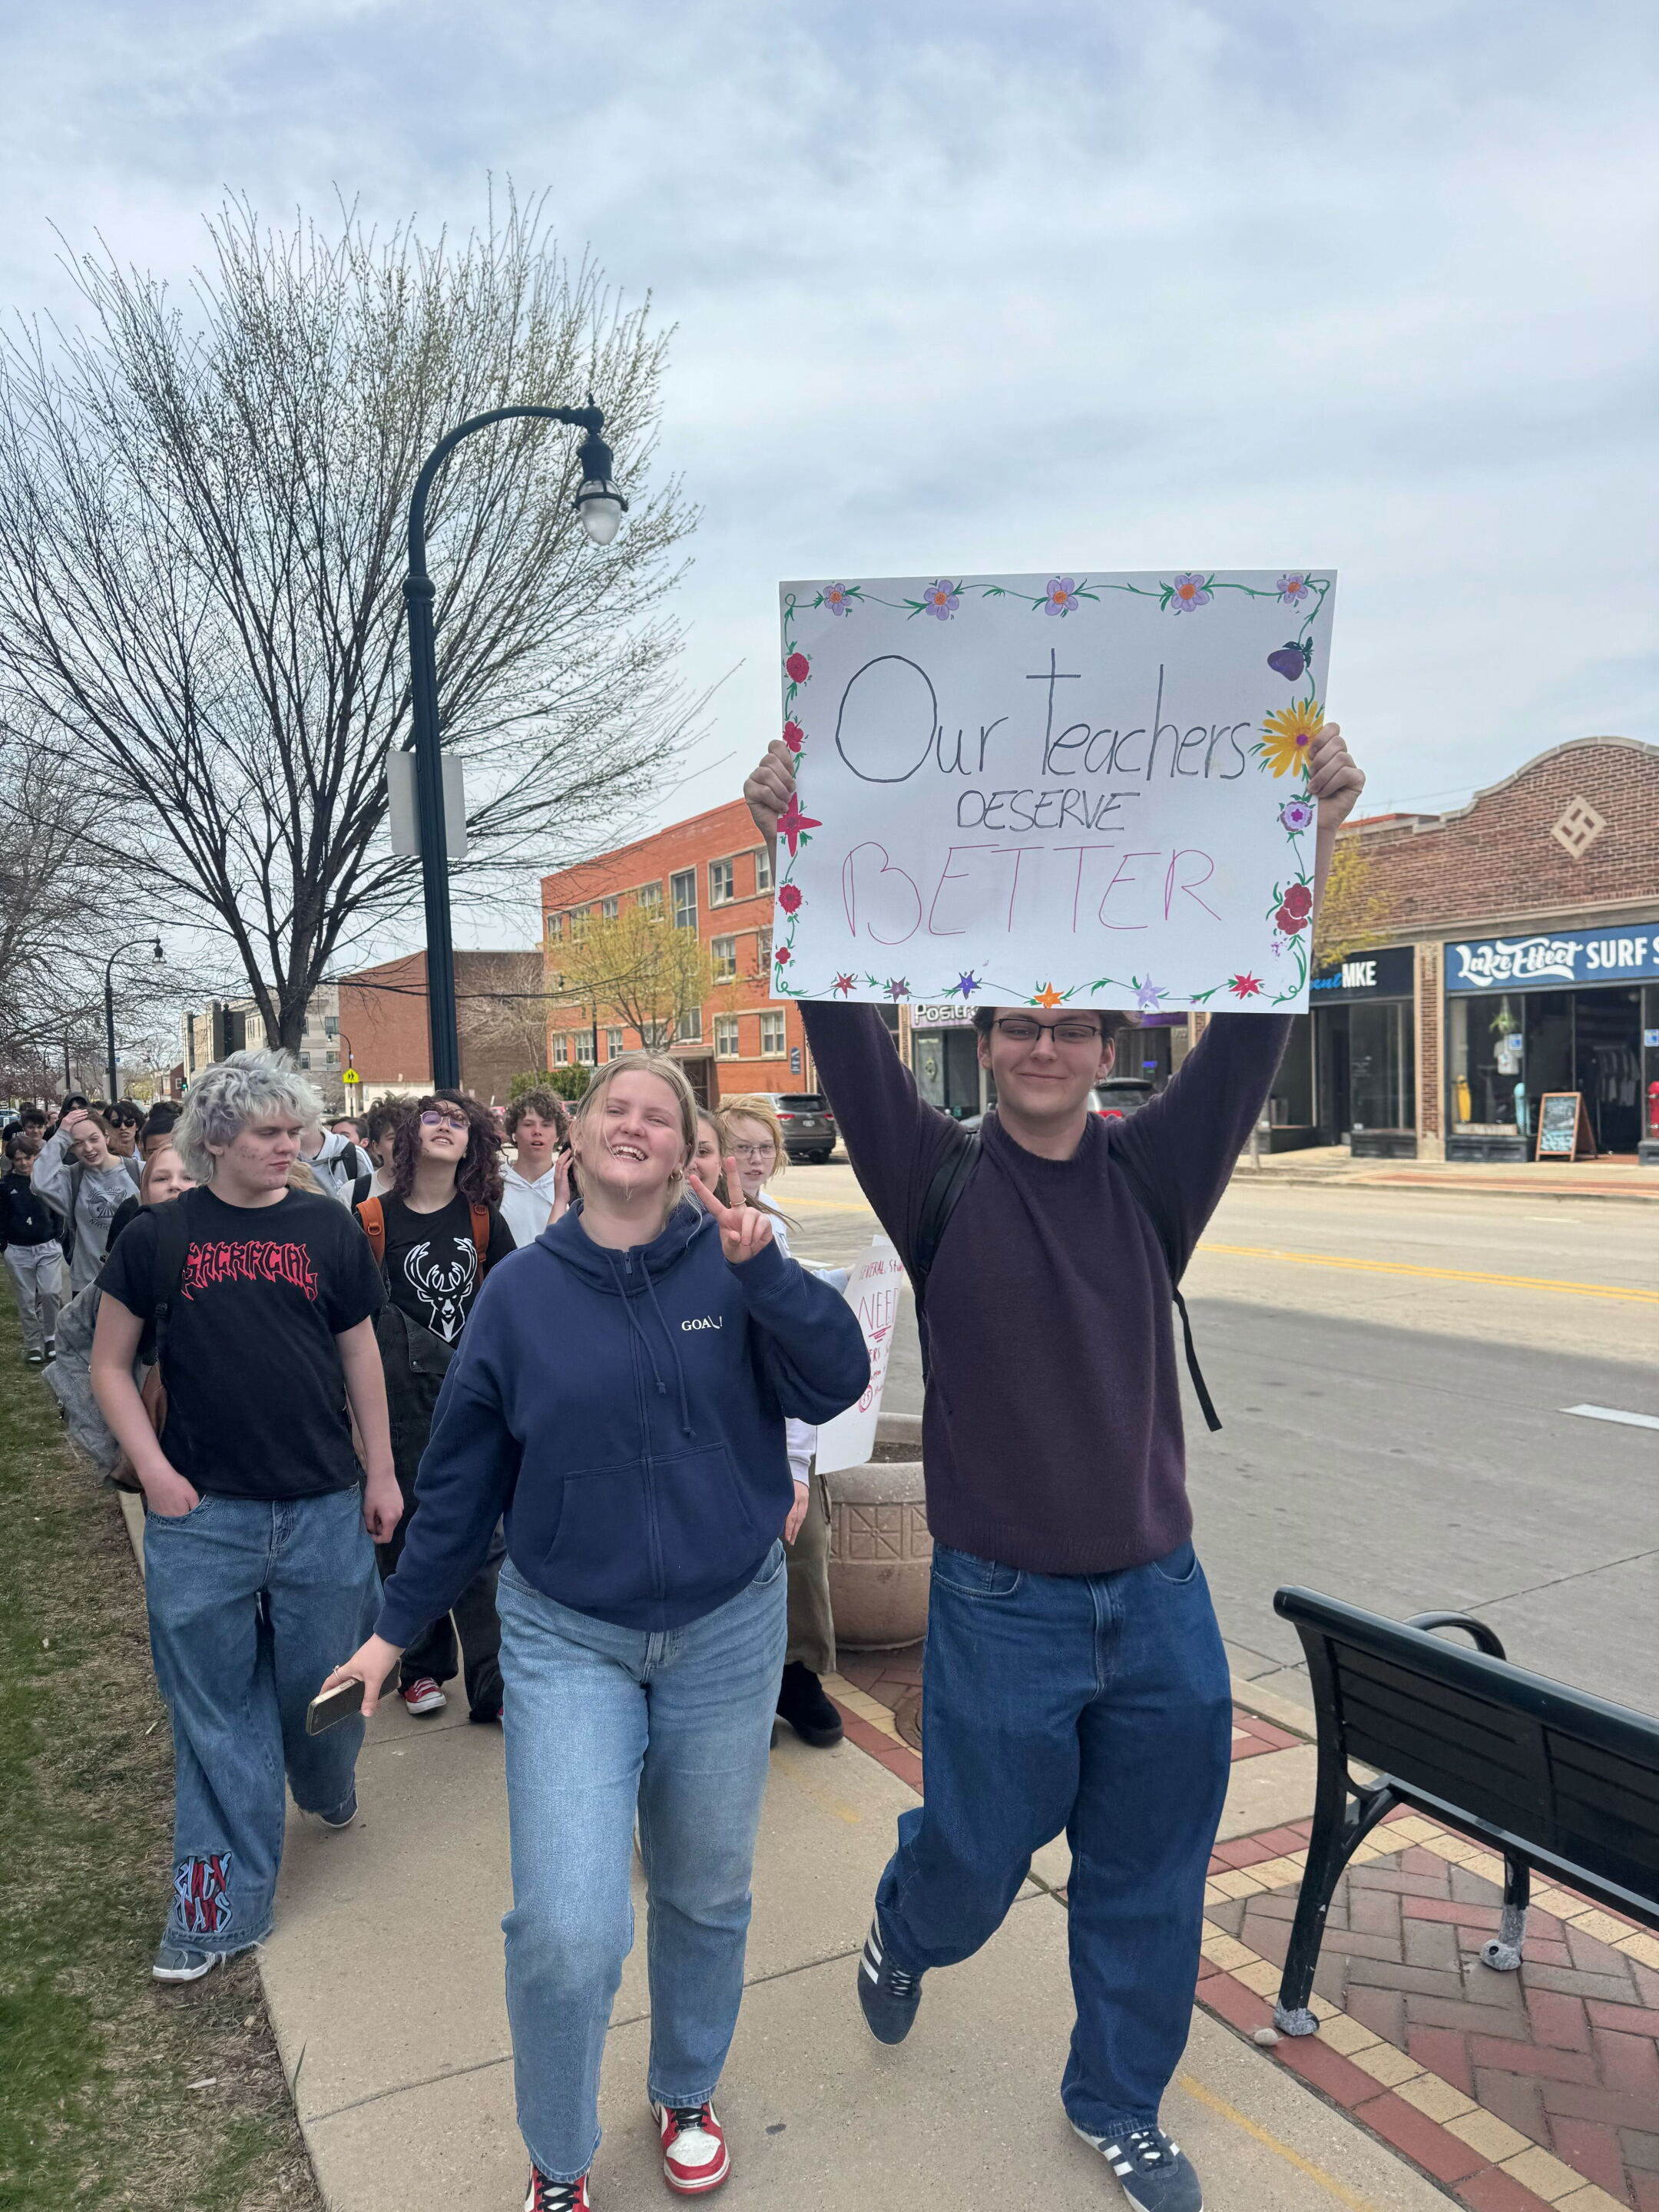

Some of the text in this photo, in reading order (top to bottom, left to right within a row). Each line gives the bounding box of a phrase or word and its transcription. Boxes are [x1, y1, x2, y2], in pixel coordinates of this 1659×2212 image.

[836, 647, 1250, 783] Our teachers
[958, 789, 1140, 832] DESERVE
[843, 842, 1222, 945] BETTER
[1342, 960, 1377, 988] MKE
[1455, 944, 1512, 987] Lake
[1495, 936, 1584, 982] Effect
[1586, 937, 1647, 969] SURF
[26, 1216, 33, 1226] 4
